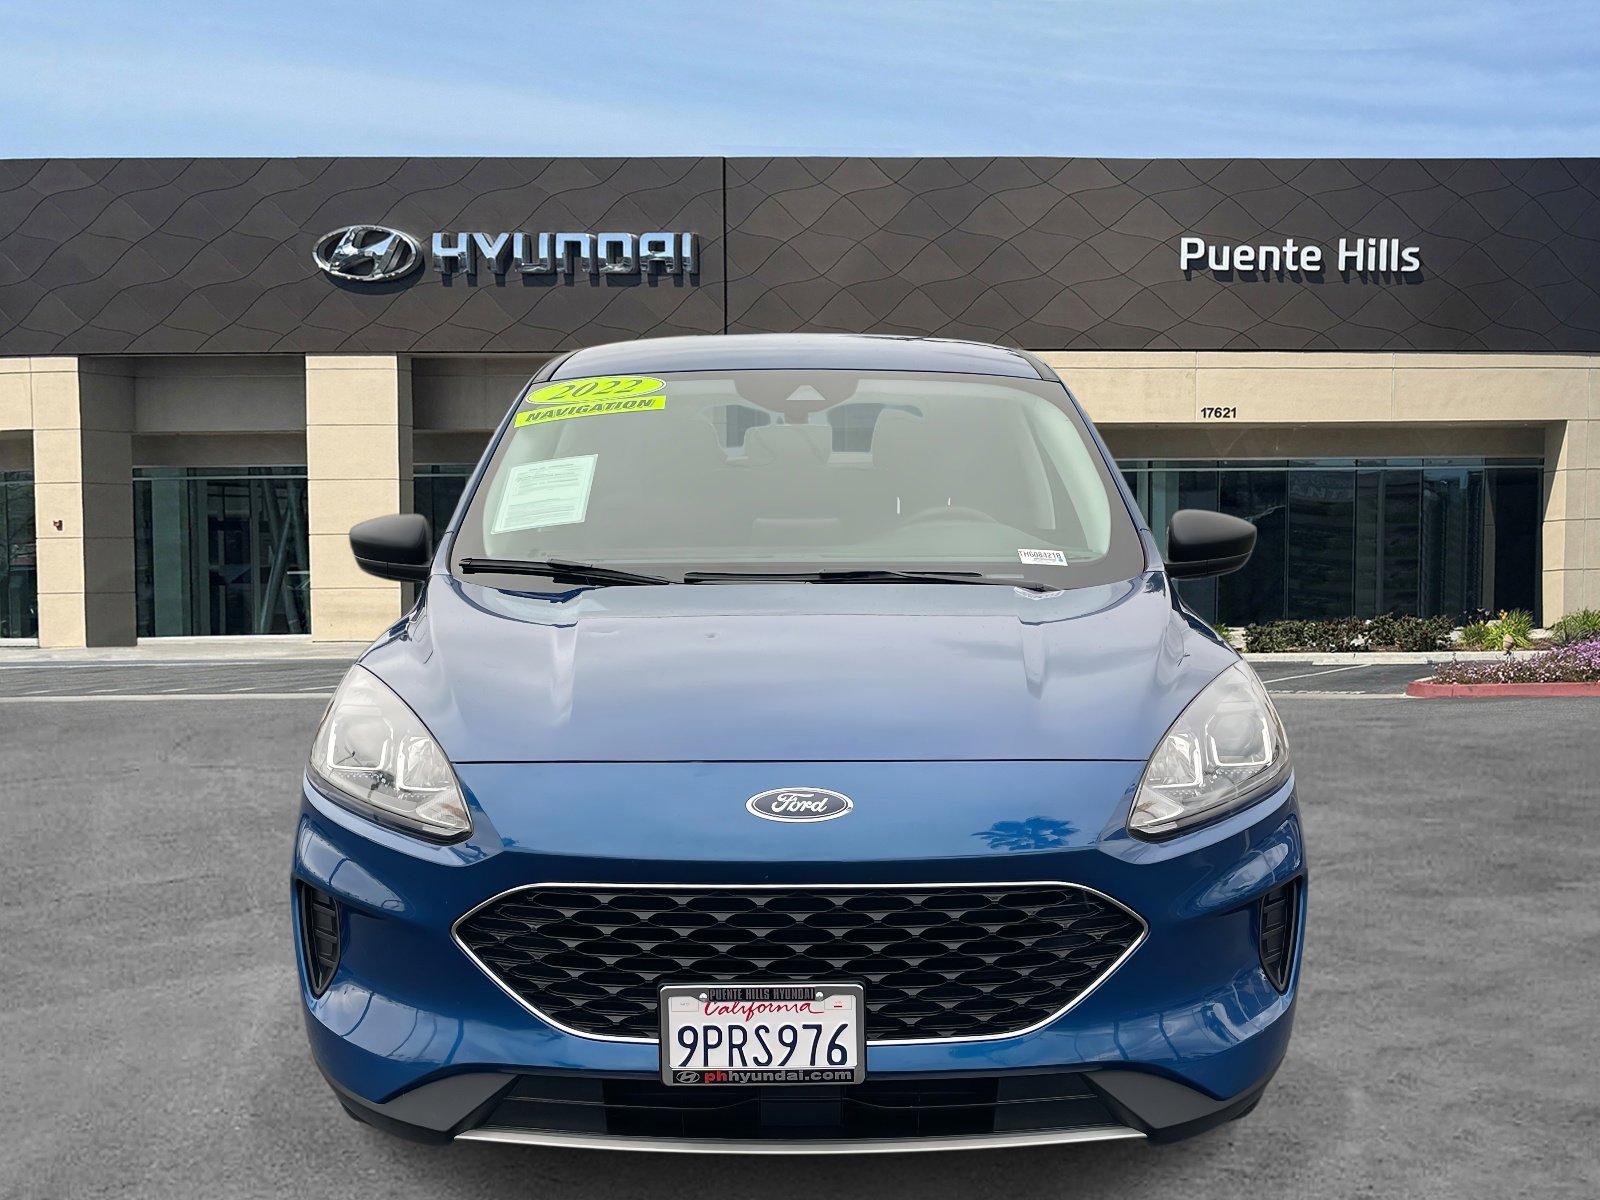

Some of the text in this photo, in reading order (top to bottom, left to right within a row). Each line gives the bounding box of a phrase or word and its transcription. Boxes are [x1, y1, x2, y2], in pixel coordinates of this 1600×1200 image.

[432, 232, 699, 274] HYUNDAI
[1180, 237, 1420, 272] Puente Hills
[547, 379, 642, 401] 2022
[525, 399, 655, 422] NAVIGATION
[1200, 406, 1237, 419] 17621
[771, 792, 829, 813] Ford
[709, 988, 814, 1000] PUENTE HILLS HYUNDAI
[704, 1001, 824, 1022] California
[677, 1023, 849, 1067] 9PRS976
[704, 1069, 852, 1084] phhyundai.com
